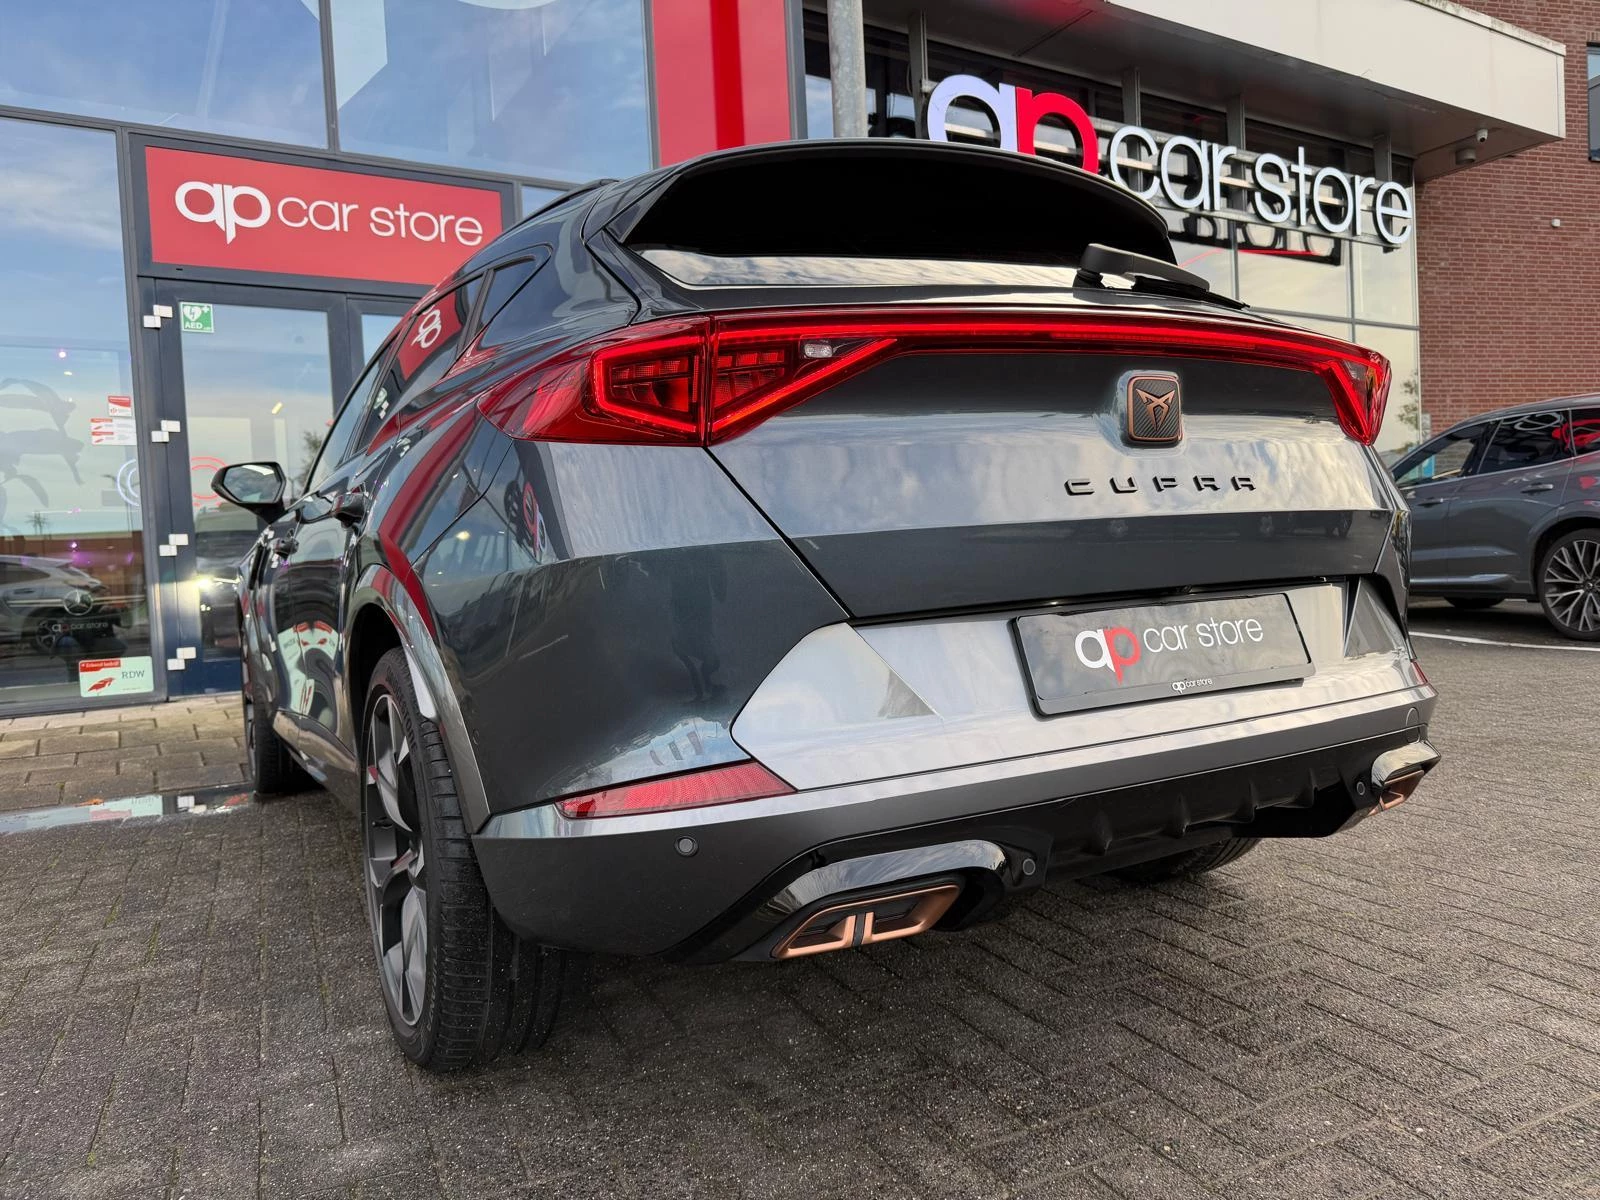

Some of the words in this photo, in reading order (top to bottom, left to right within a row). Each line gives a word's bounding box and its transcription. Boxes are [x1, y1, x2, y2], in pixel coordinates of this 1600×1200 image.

[1107, 125, 1237, 210] car
[1253, 146, 1413, 245] store
[174, 181, 271, 244] ap
[277, 197, 359, 232] car
[369, 203, 483, 246] store
[184, 321, 203, 329] AED
[1064, 475, 1257, 496] CUPRA
[1075, 626, 1142, 685] ap
[1143, 624, 1189, 653] car
[1196, 617, 1264, 647] store
[121, 670, 145, 679] RDW
